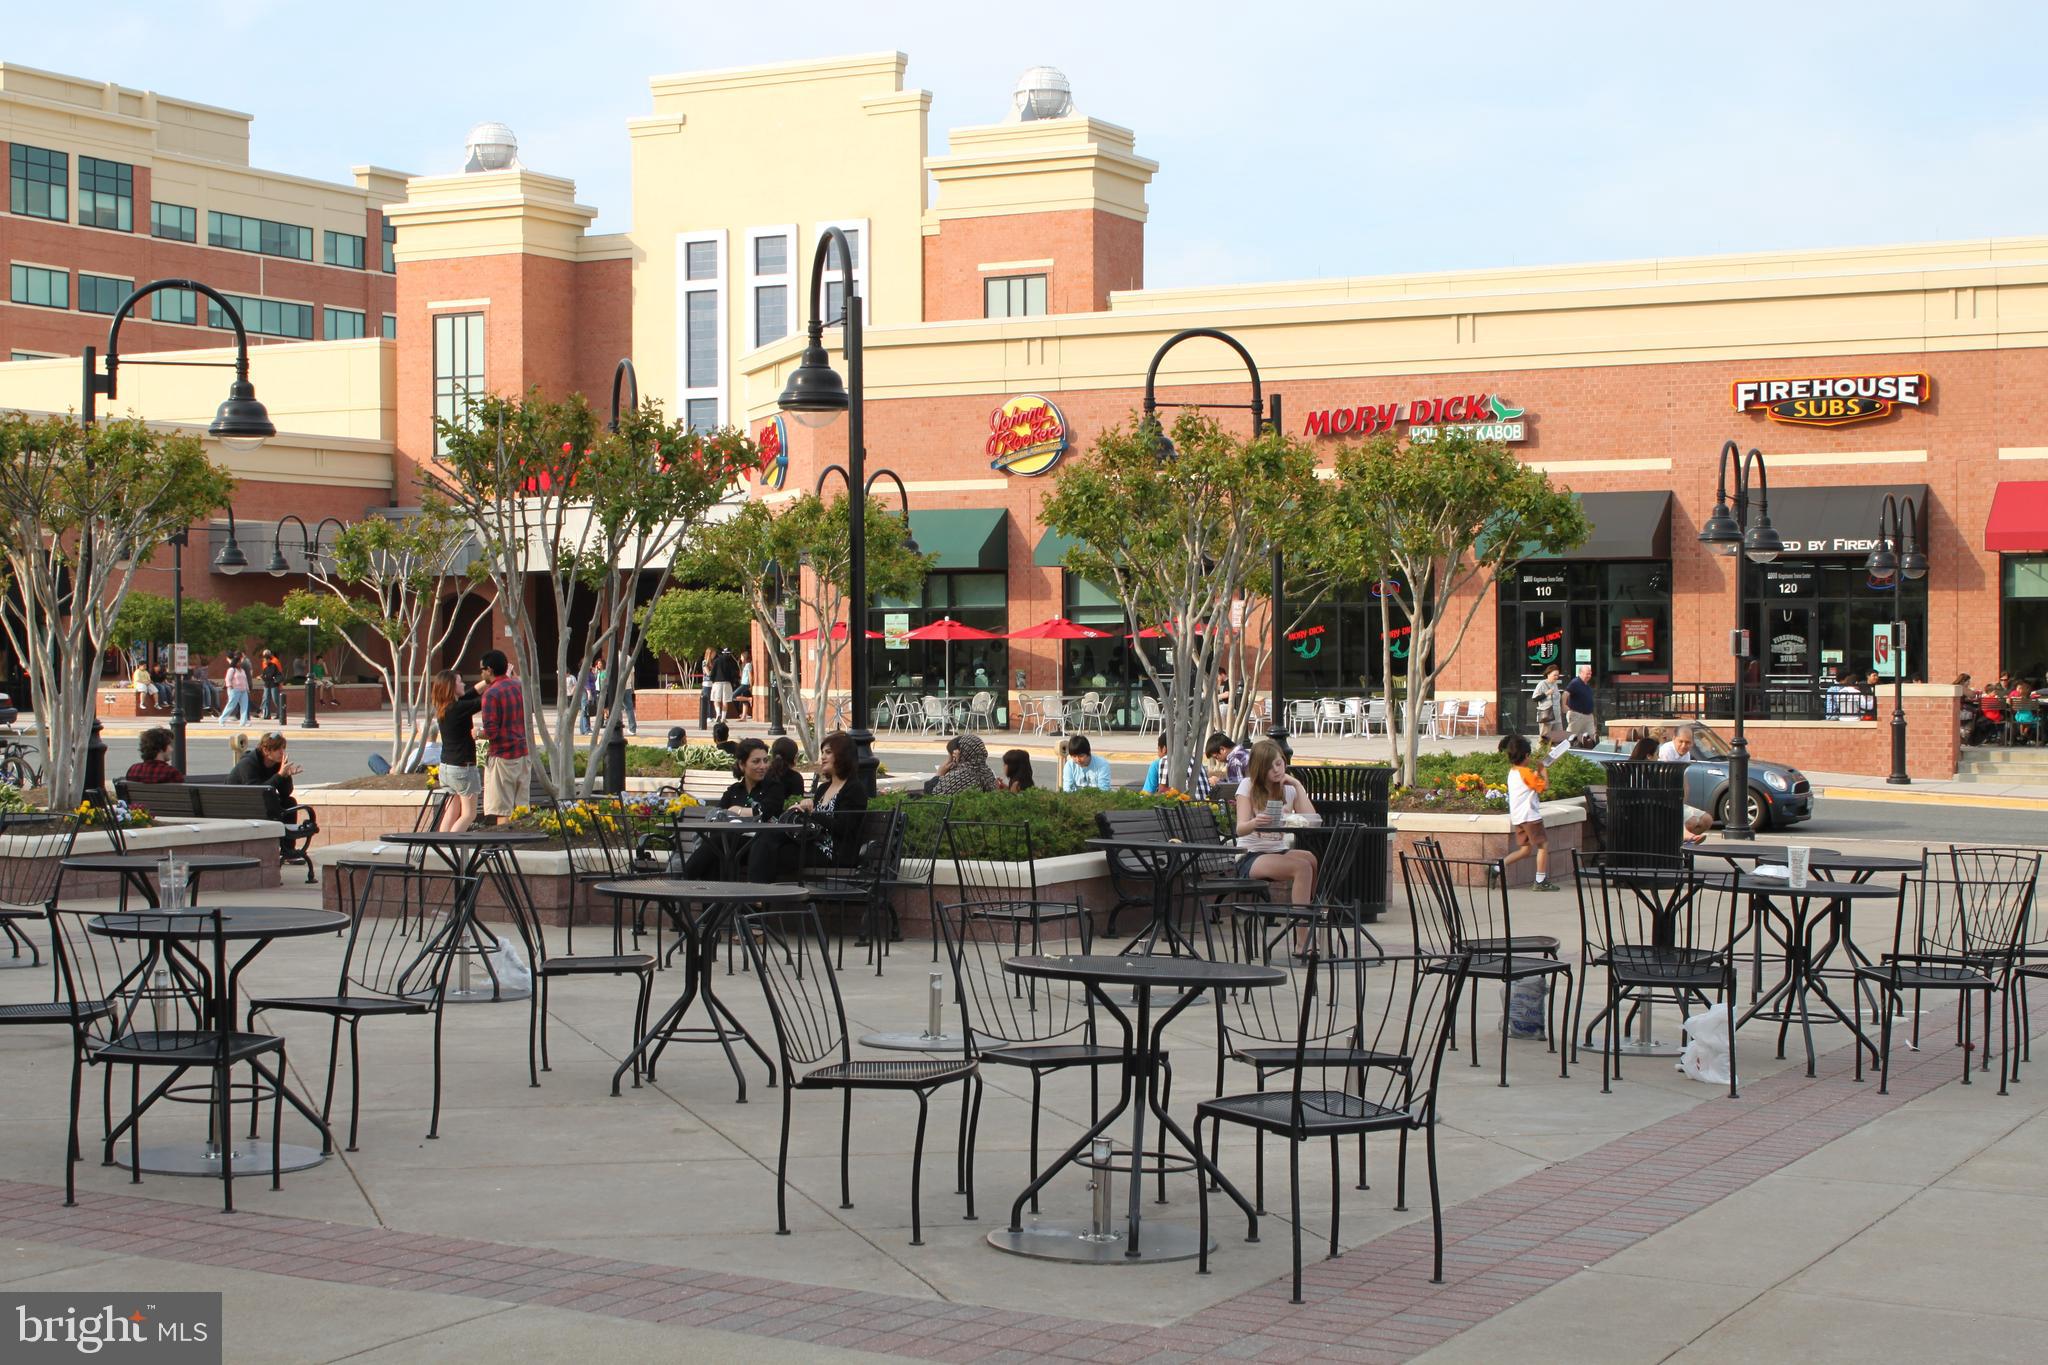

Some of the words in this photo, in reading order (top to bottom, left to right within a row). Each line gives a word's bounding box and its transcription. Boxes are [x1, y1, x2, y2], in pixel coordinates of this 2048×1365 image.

[1736, 375, 1920, 413] FIREHOUSE
[1303, 403, 1398, 436] MOBY
[1408, 394, 1490, 426] DICK
[1793, 398, 1861, 417] SUBS
[986, 403, 1053, 450] Johnny
[1000, 421, 1064, 451] Rockets
[1476, 424, 1522, 440] KABOB
[1807, 540, 1828, 551] BY
[1535, 586, 1552, 597] 110
[1778, 583, 1798, 594] 120
